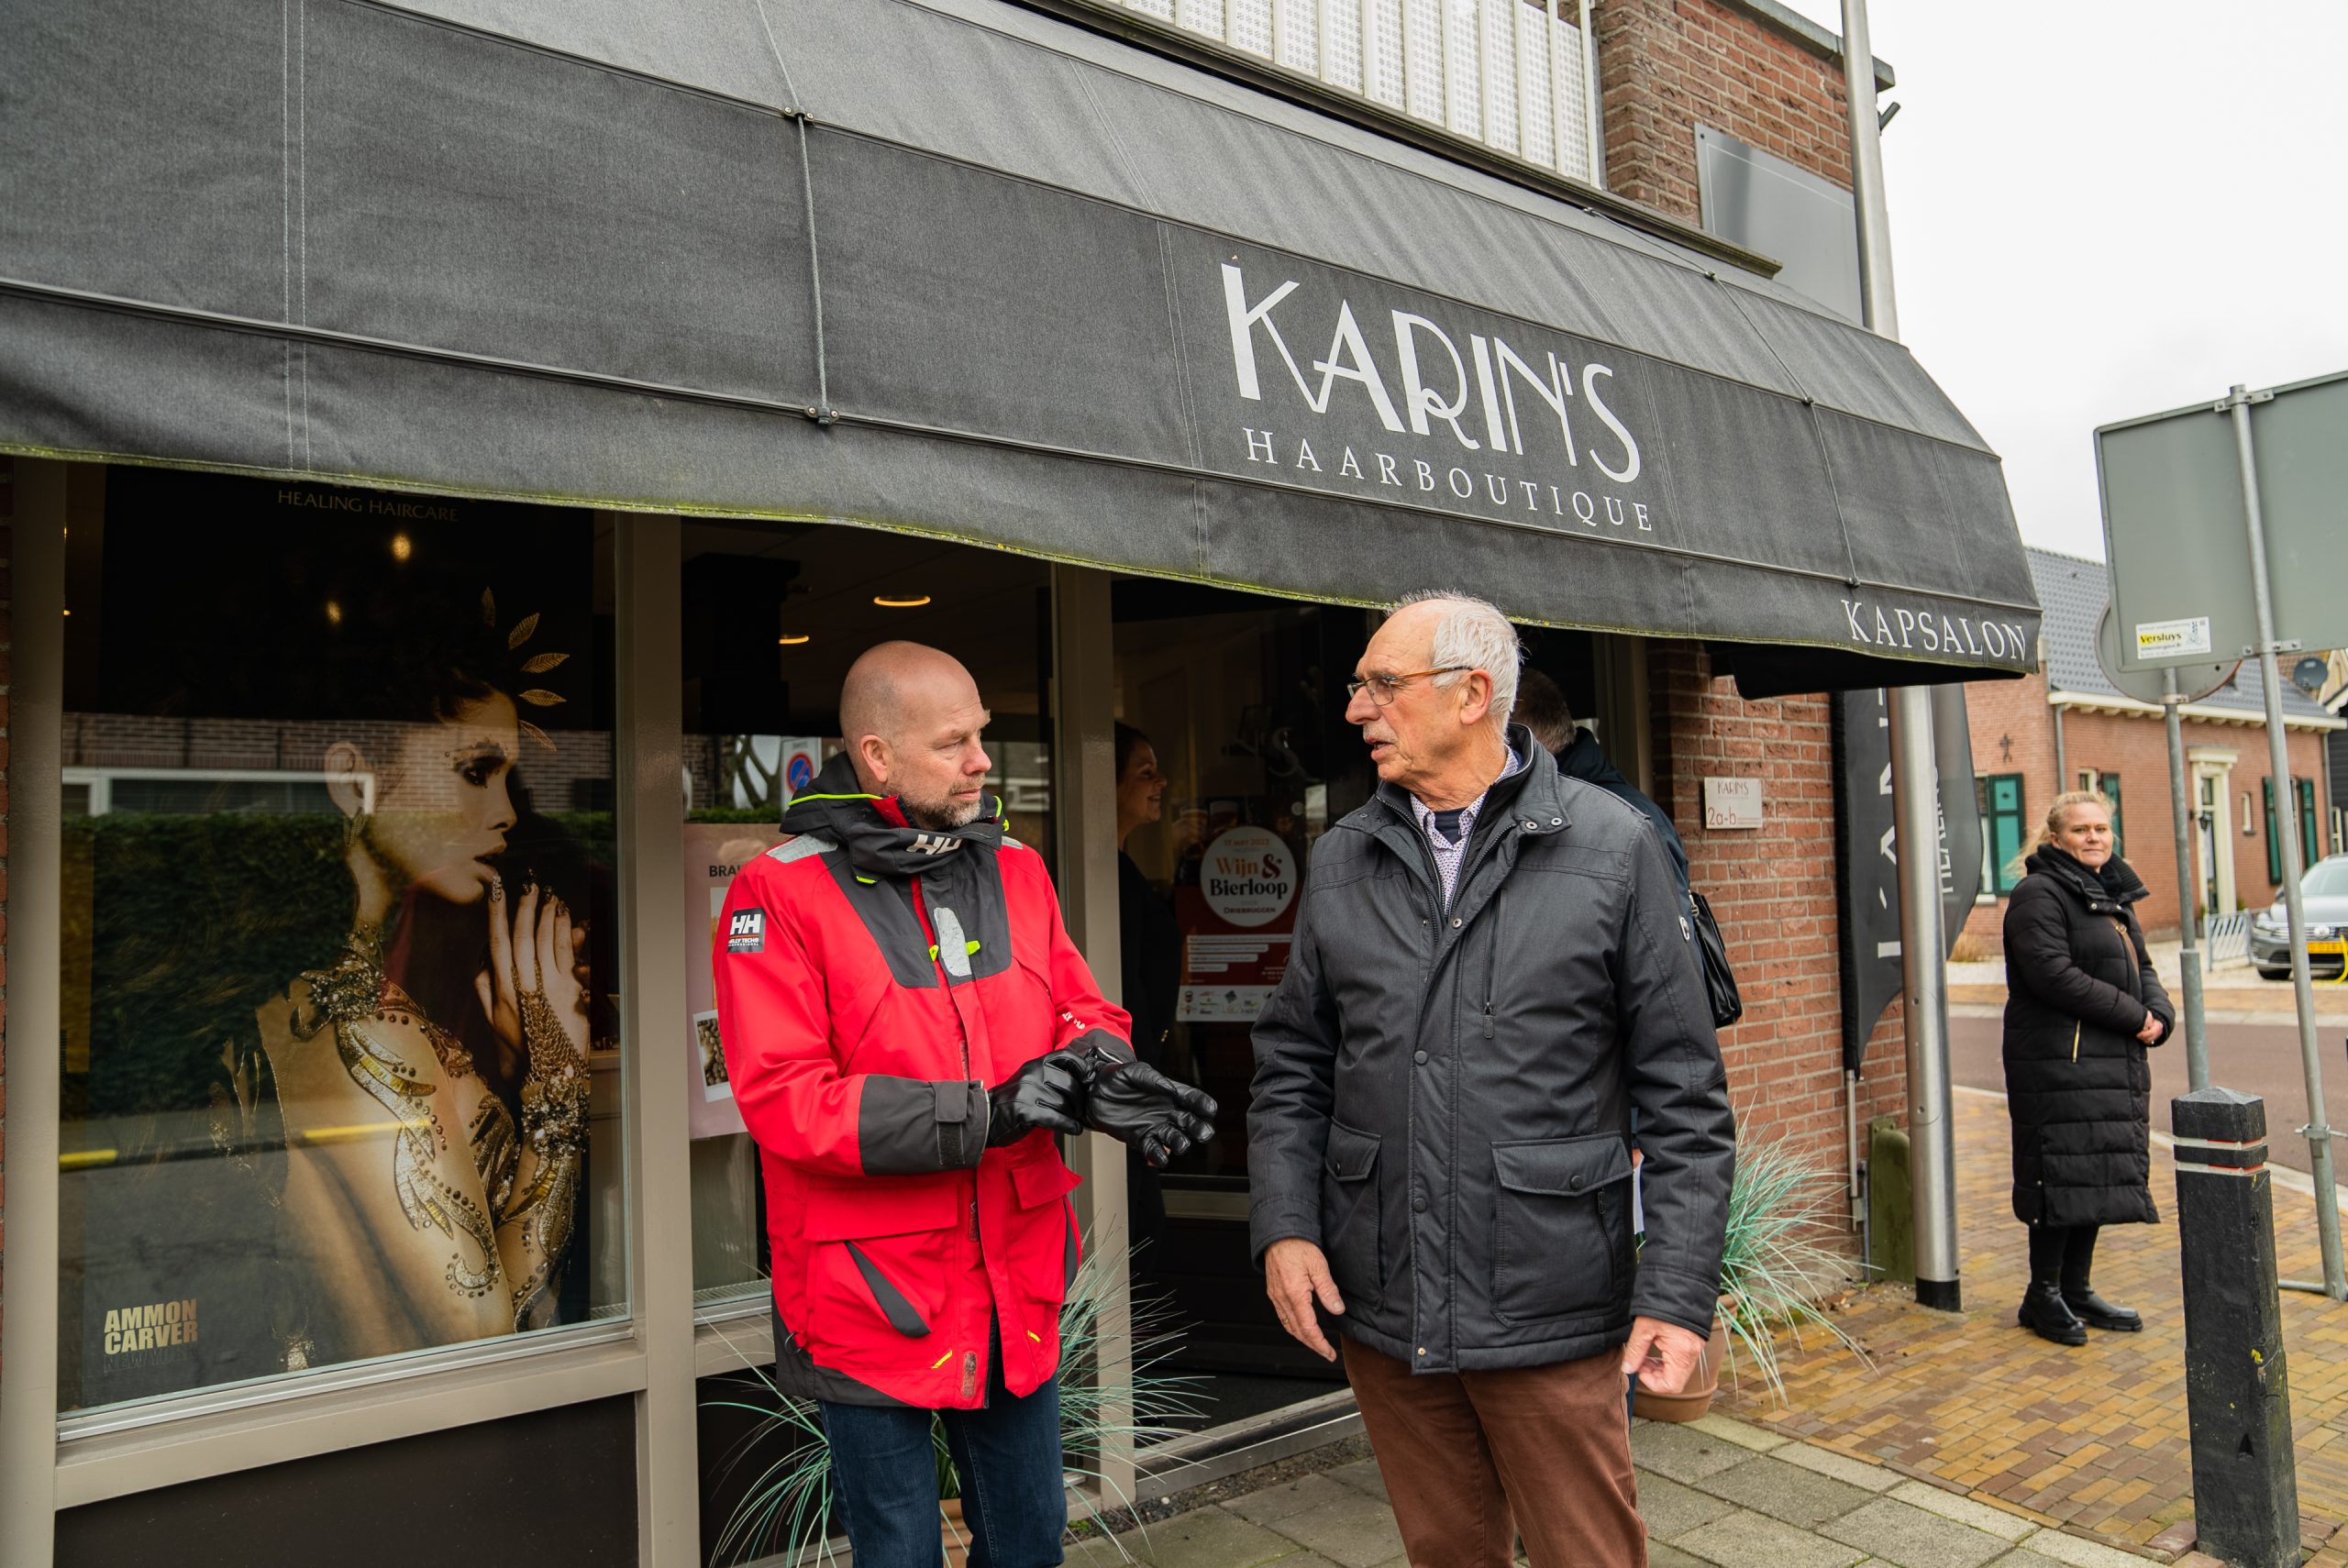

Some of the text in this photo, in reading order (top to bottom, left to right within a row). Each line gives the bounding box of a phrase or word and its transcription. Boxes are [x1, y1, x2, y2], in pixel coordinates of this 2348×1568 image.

[1221, 262, 1641, 483] KARIN'S
[1242, 427, 1652, 531] HAARBOUTIQUE
[278, 490, 362, 513] HEALING
[370, 500, 459, 522] HAIRCARE
[1841, 600, 2026, 661] KAPSALON
[1215, 853, 1282, 878] Wijn &
[1210, 878, 1288, 900] Bierloop
[729, 913, 762, 935] HH
[104, 1298, 196, 1332] AMMON
[104, 1320, 198, 1355] CARVER
